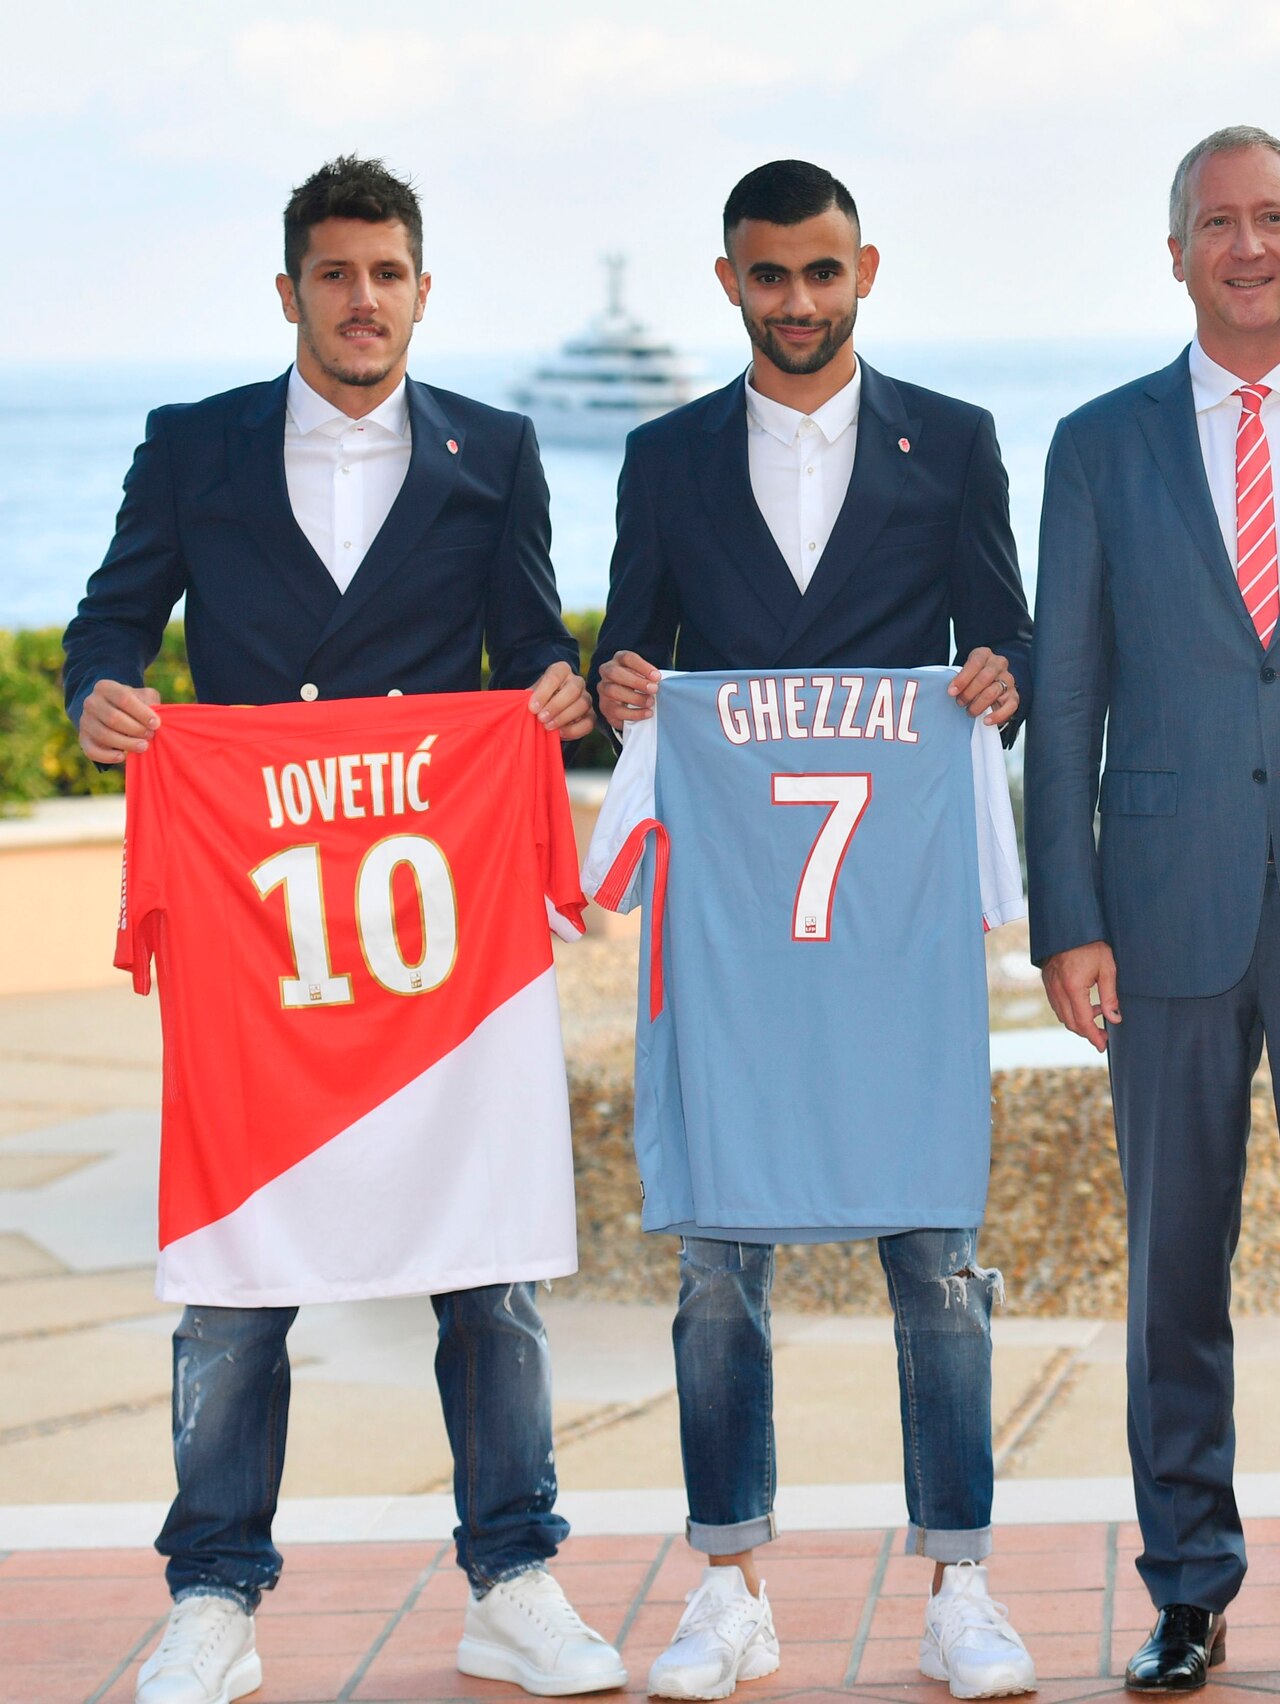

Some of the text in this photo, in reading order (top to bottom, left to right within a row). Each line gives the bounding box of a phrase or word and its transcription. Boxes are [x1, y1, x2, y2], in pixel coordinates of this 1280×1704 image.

[716, 675, 920, 745] GHEZZAL
[261, 734, 438, 829] JOVETIĆ
[247, 833, 458, 1009] 10
[770, 772, 872, 942] 7
